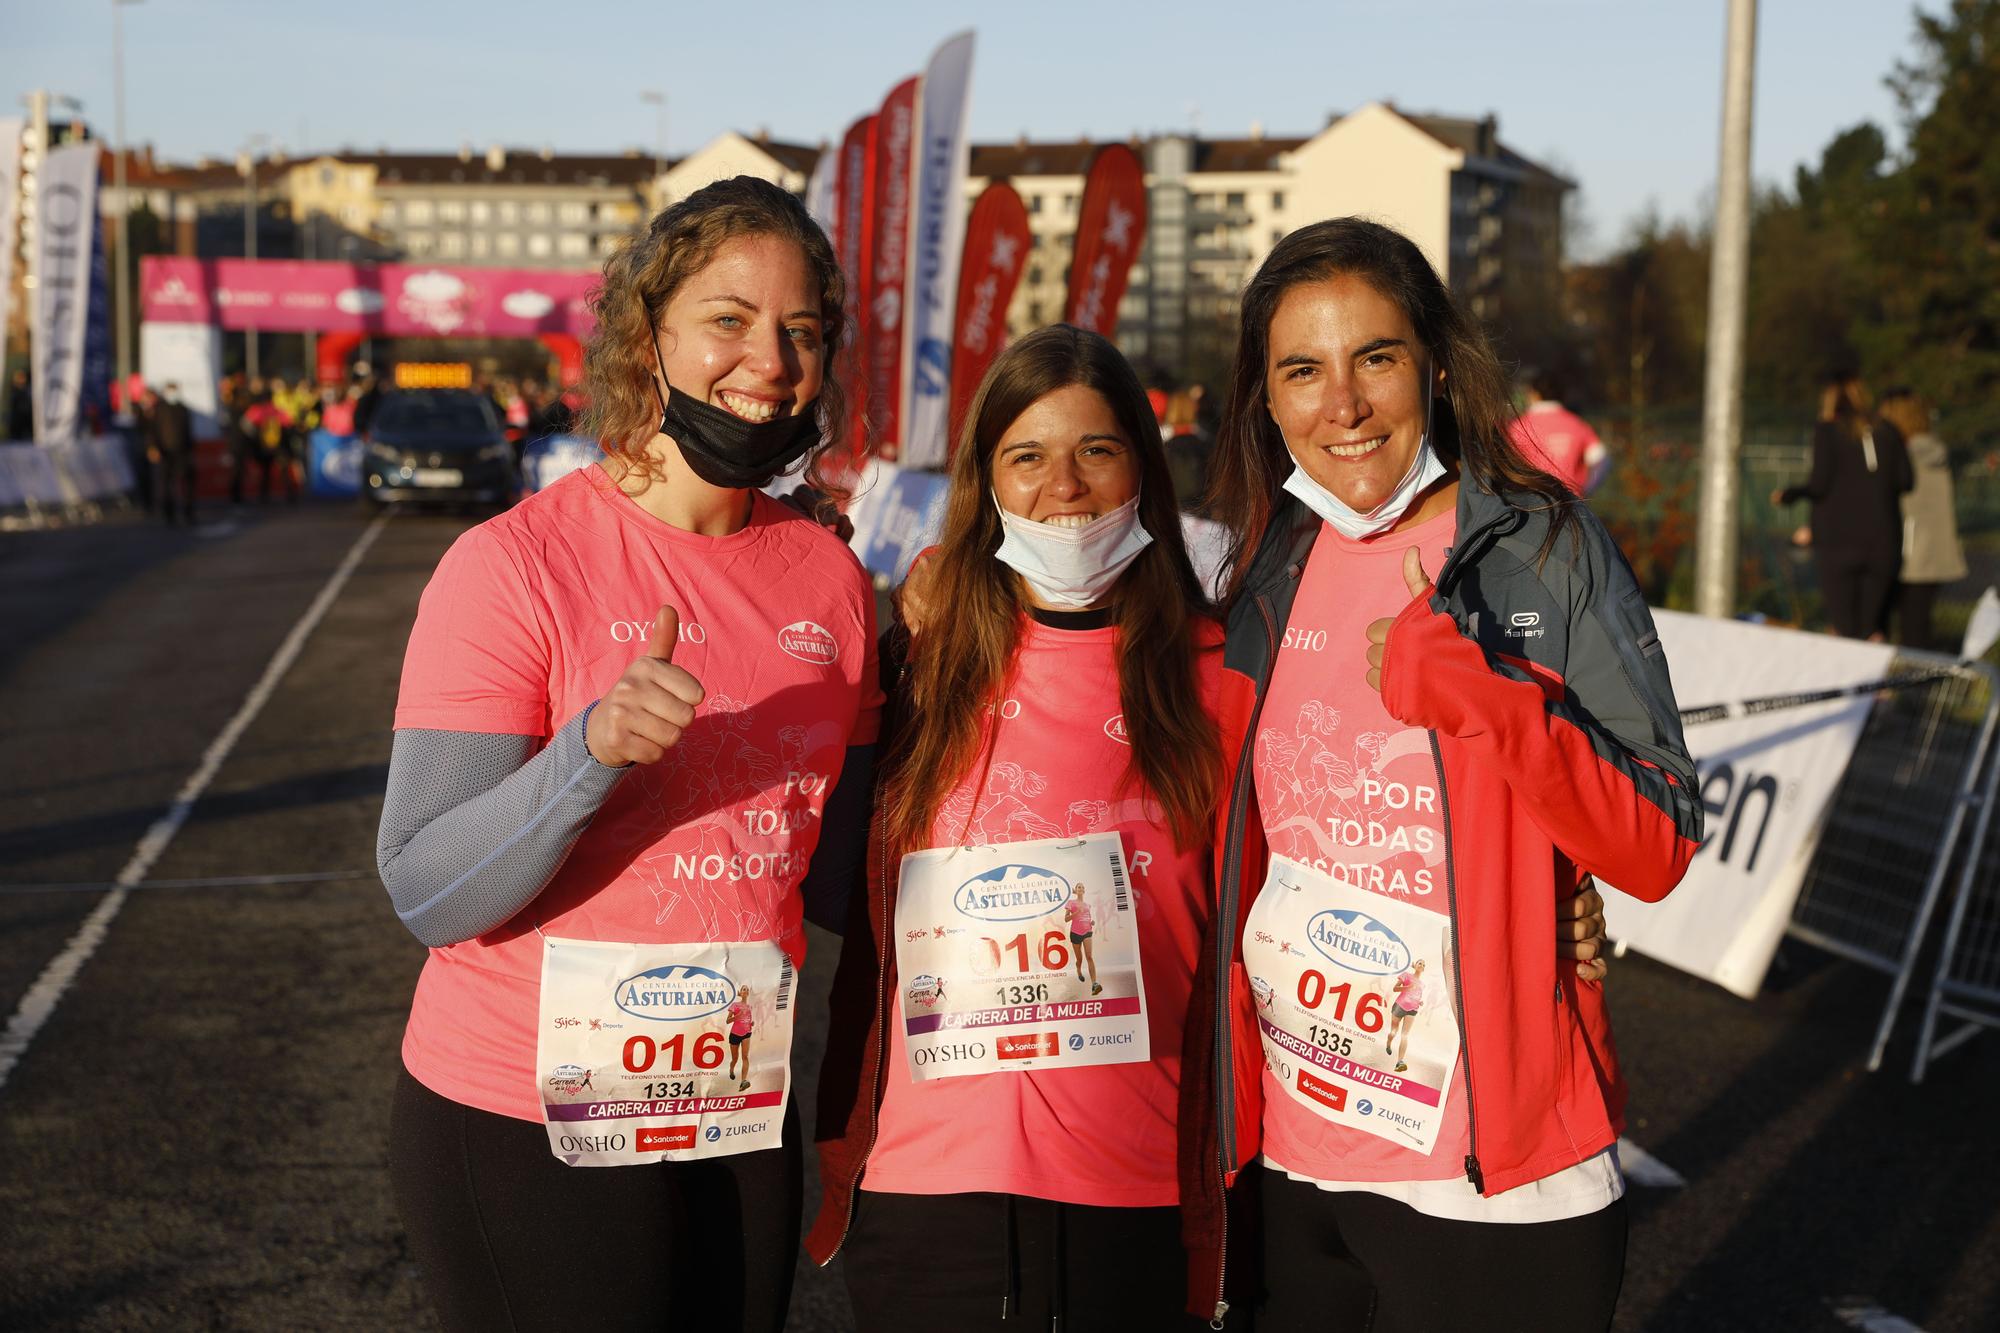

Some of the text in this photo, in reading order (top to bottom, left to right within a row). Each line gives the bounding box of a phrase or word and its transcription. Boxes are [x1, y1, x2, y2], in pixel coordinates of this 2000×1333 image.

[610, 621, 706, 644] OYO
[1281, 628, 1327, 652] SHO
[1364, 779, 1435, 813] POR
[1327, 817, 1434, 853] TODAS
[673, 848, 806, 881] NOSOTRAS
[1289, 855, 1433, 895] SOTRAS
[964, 887, 1063, 911] ASTURIANA
[1311, 919, 1399, 969] ASTURIANA
[623, 984, 727, 1006] ASTURIANA
[996, 984, 1048, 1005] 1336
[1297, 969, 1384, 1033] 016
[944, 1002, 1102, 1028] CARRERA DE LA MUJER
[1089, 1033, 1132, 1046] ZURICH
[1309, 1024, 1353, 1057] 1335
[622, 1032, 725, 1073] 016
[915, 1042, 986, 1066] OYSHO
[1269, 1027, 1403, 1091] CARRERA DE LA MUJER
[548, 1077, 576, 1087] Carrera
[643, 1080, 695, 1099] 1334
[1309, 1083, 1339, 1102] Santander
[588, 1097, 746, 1118] CARRERA DE LA MUJER
[1377, 1107, 1421, 1130] ZURICH
[653, 1134, 689, 1143] Santander
[725, 1123, 766, 1137] ZURICH
[560, 1133, 626, 1152] OYSHO
